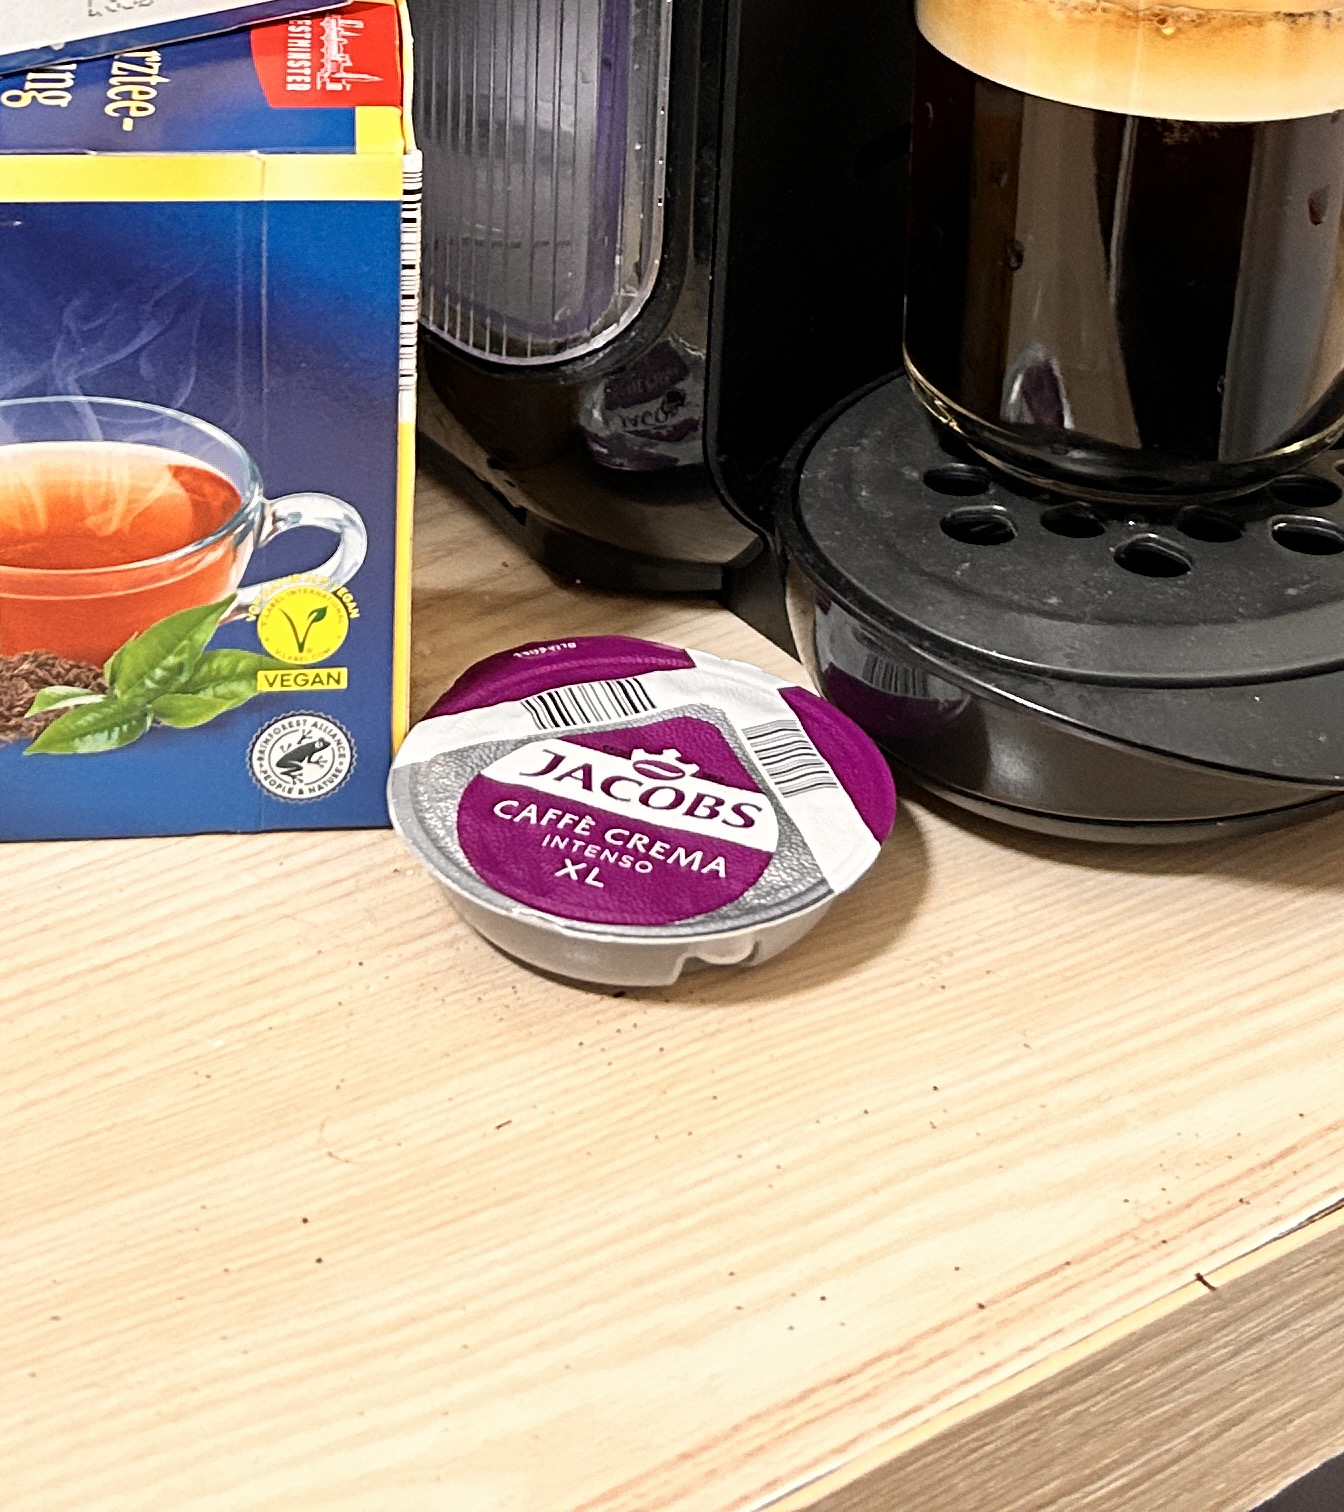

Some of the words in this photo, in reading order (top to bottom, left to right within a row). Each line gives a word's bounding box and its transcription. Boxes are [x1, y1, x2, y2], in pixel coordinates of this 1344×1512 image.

[285, 14, 313, 92] ESTMINSTER
[263, 671, 342, 688] VEGAN
[256, 719, 308, 762] RAINFOREST
[519, 748, 764, 829] JACOBS
[492, 799, 596, 836] CAFFÈ
[603, 827, 728, 879] CREMA
[541, 833, 654, 874] INTENSO
[554, 857, 606, 889] XL
